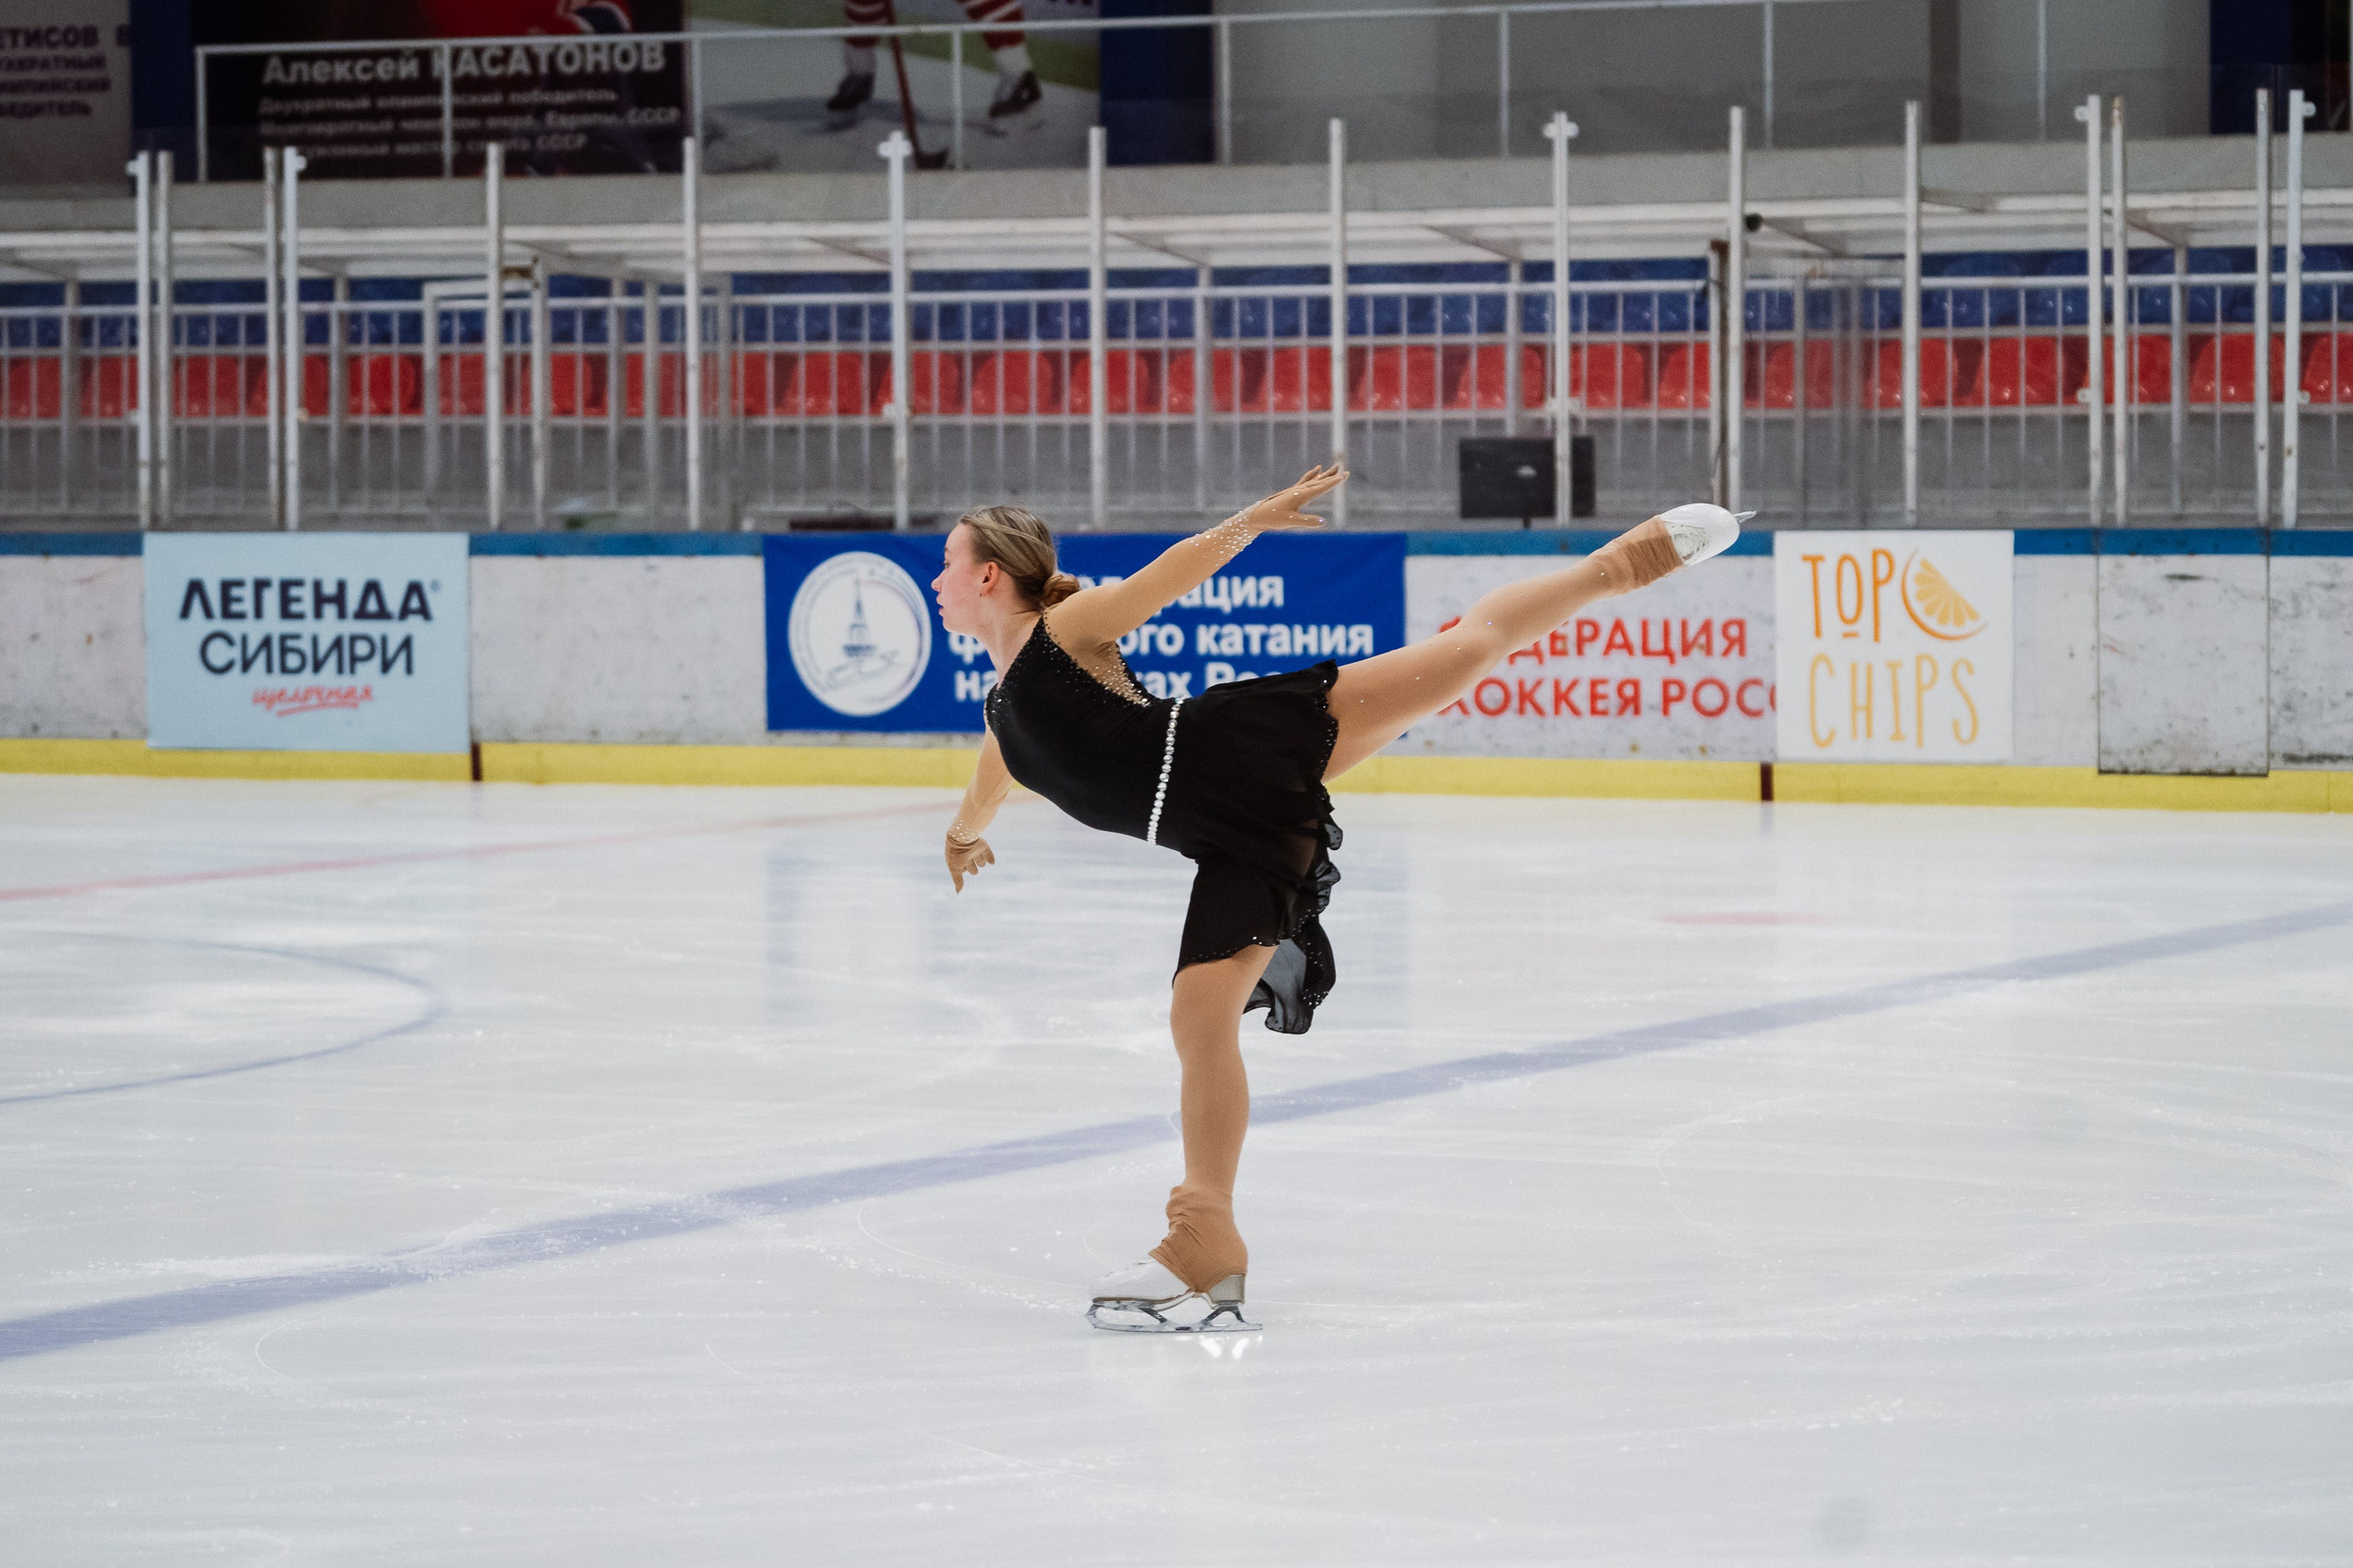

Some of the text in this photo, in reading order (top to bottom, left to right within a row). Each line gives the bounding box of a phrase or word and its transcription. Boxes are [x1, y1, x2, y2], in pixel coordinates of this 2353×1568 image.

[263, 49, 419, 84] Алексей
[178, 577, 433, 620] ЛЕГЕНДА
[1802, 548, 1895, 642] TOP
[199, 631, 414, 675] СИБИРИ
[1196, 623, 1375, 655] катания
[1662, 677, 1776, 718] РОС
[1809, 653, 1979, 749] CHIPS
